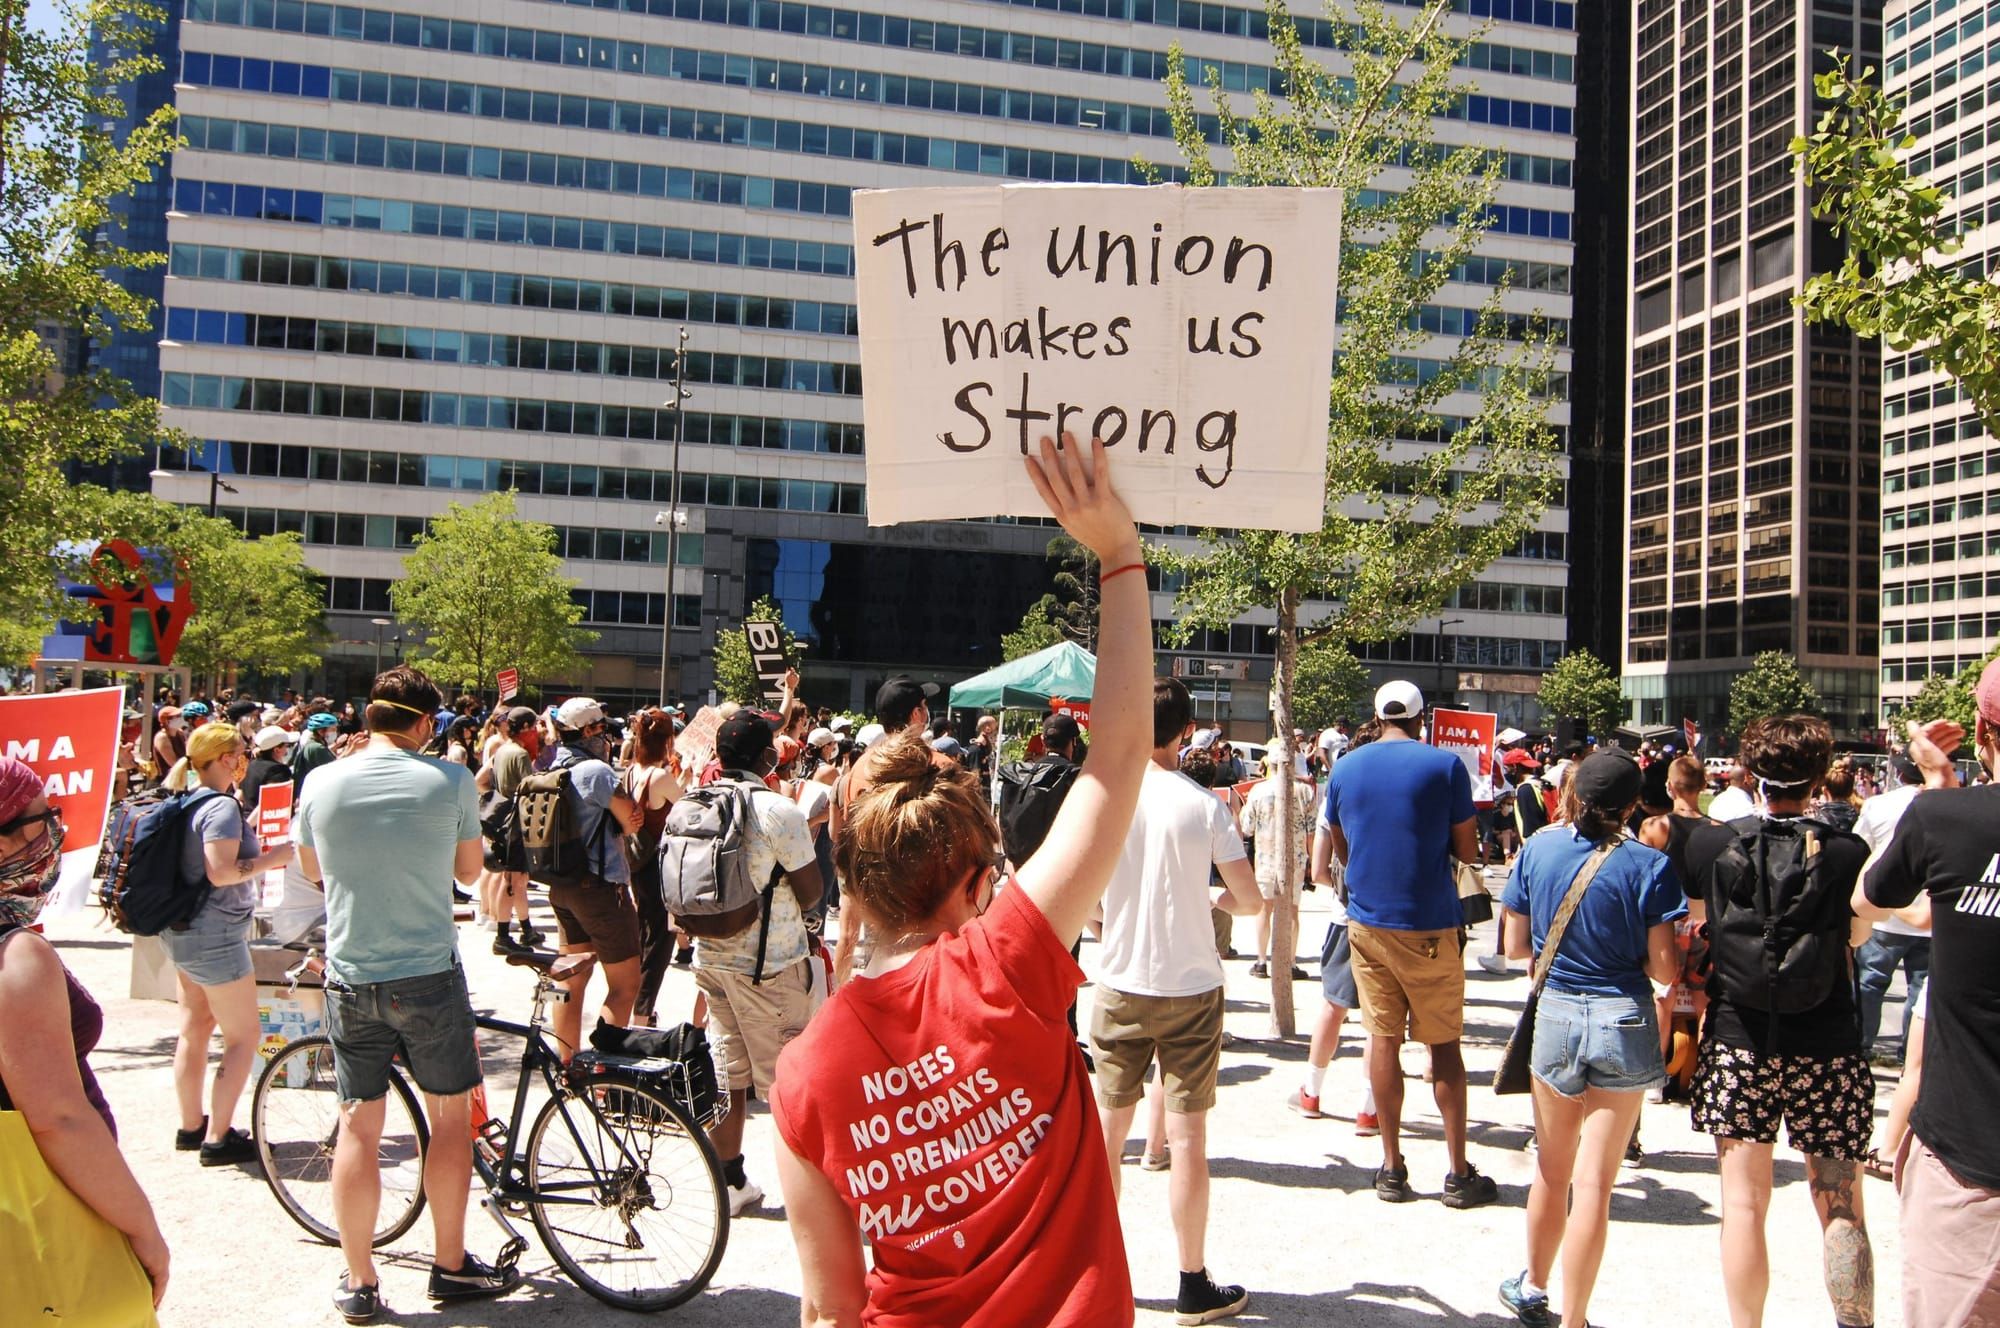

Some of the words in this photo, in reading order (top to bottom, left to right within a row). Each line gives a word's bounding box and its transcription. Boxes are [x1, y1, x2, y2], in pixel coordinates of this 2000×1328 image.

[872, 213, 1009, 298] The
[1046, 223, 1273, 292] union
[942, 306, 1132, 364] makes
[1188, 311, 1265, 359] us
[936, 372, 1237, 489] Strong
[746, 623, 787, 700] BLM
[0, 739, 40, 763] M
[48, 735, 76, 761] A
[1439, 725, 1443, 735] I
[1446, 727, 1467, 738] AM
[1469, 729, 1480, 739] A
[850, 1114, 890, 1152] NO
[895, 1068, 999, 1136] COPAYS
[861, 1066, 908, 1104] NO
[902, 1045, 955, 1091] EES
[846, 1159, 889, 1198] NO
[891, 1087, 1032, 1182] PREMIUMS
